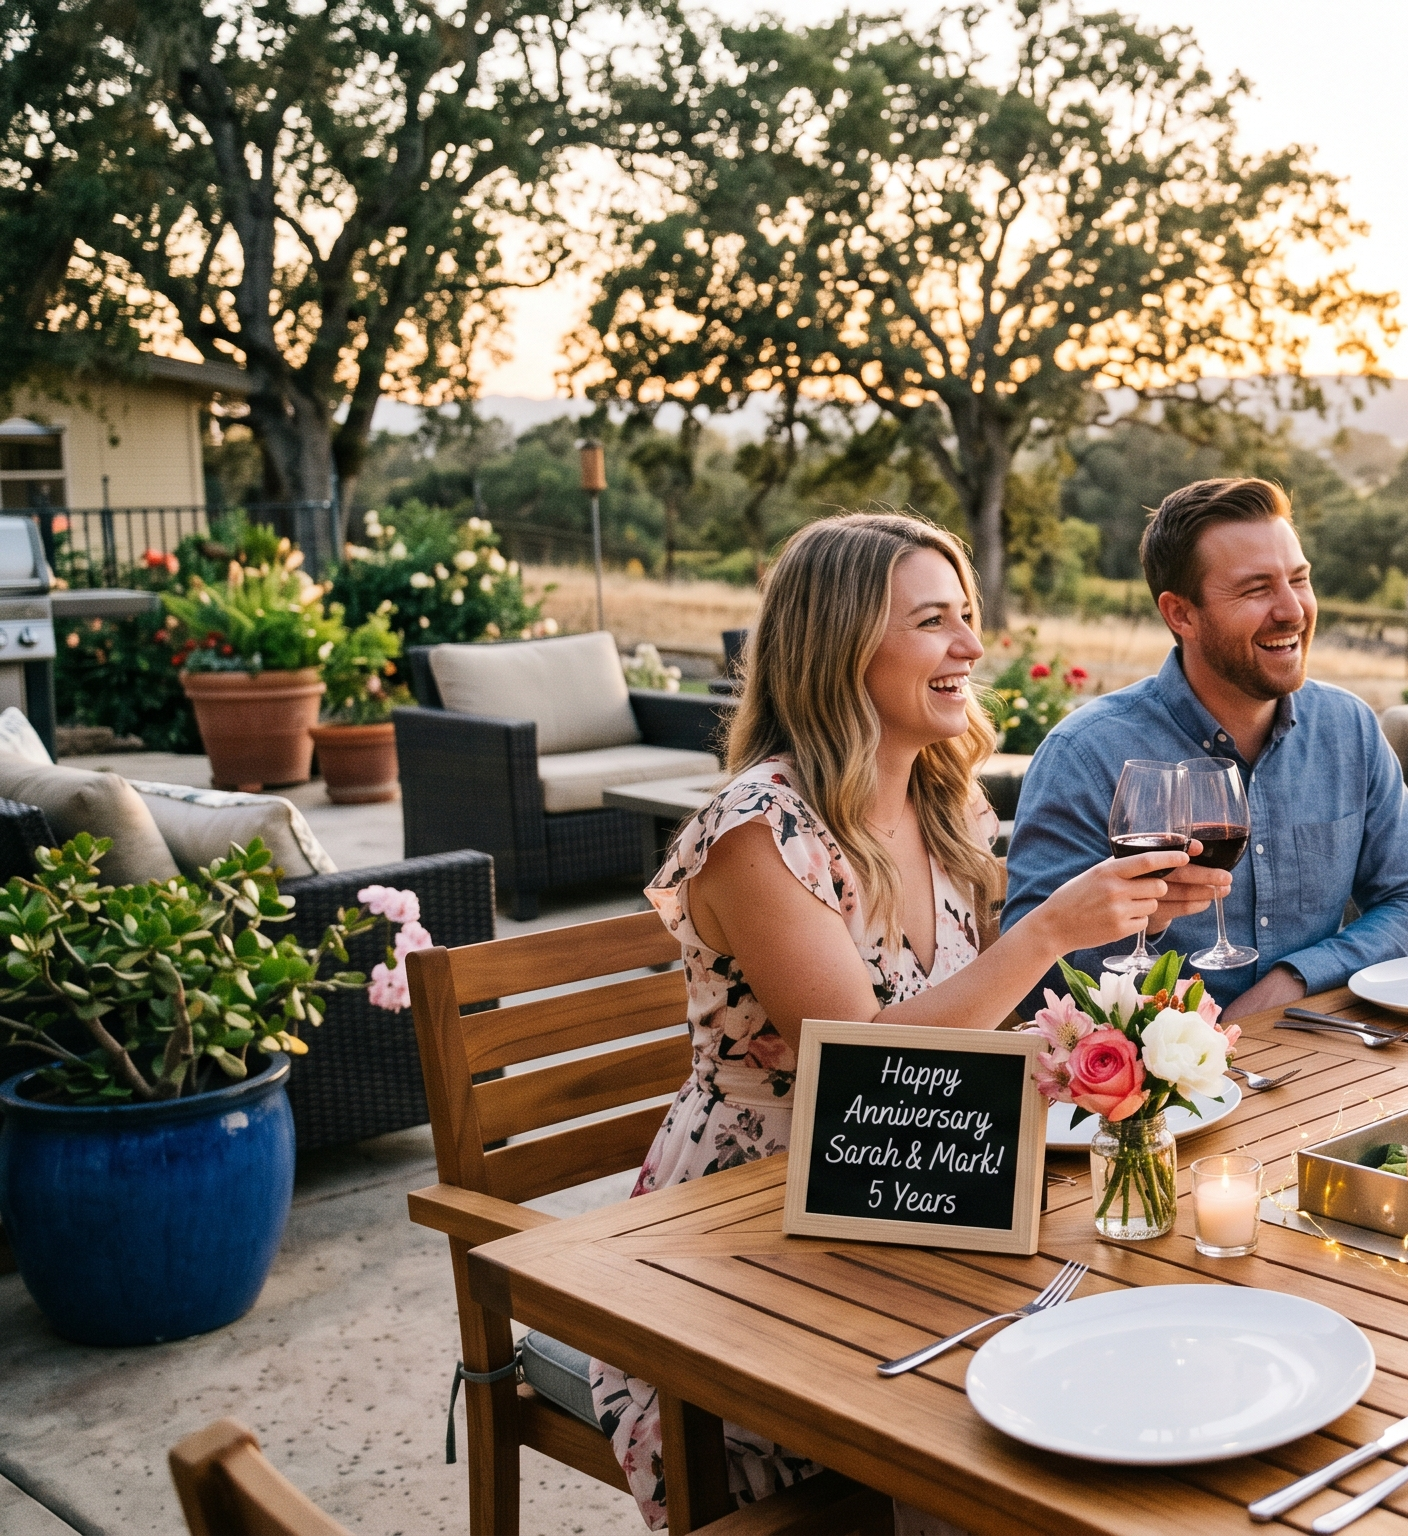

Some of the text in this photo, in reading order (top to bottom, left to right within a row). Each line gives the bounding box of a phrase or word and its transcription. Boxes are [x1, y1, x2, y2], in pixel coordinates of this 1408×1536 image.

[880, 1056, 962, 1097] Happy
[843, 1094, 993, 1141] Anniversary
[825, 1134, 1005, 1175] Sarah & Mark!
[868, 1179, 956, 1214] 5 Years
